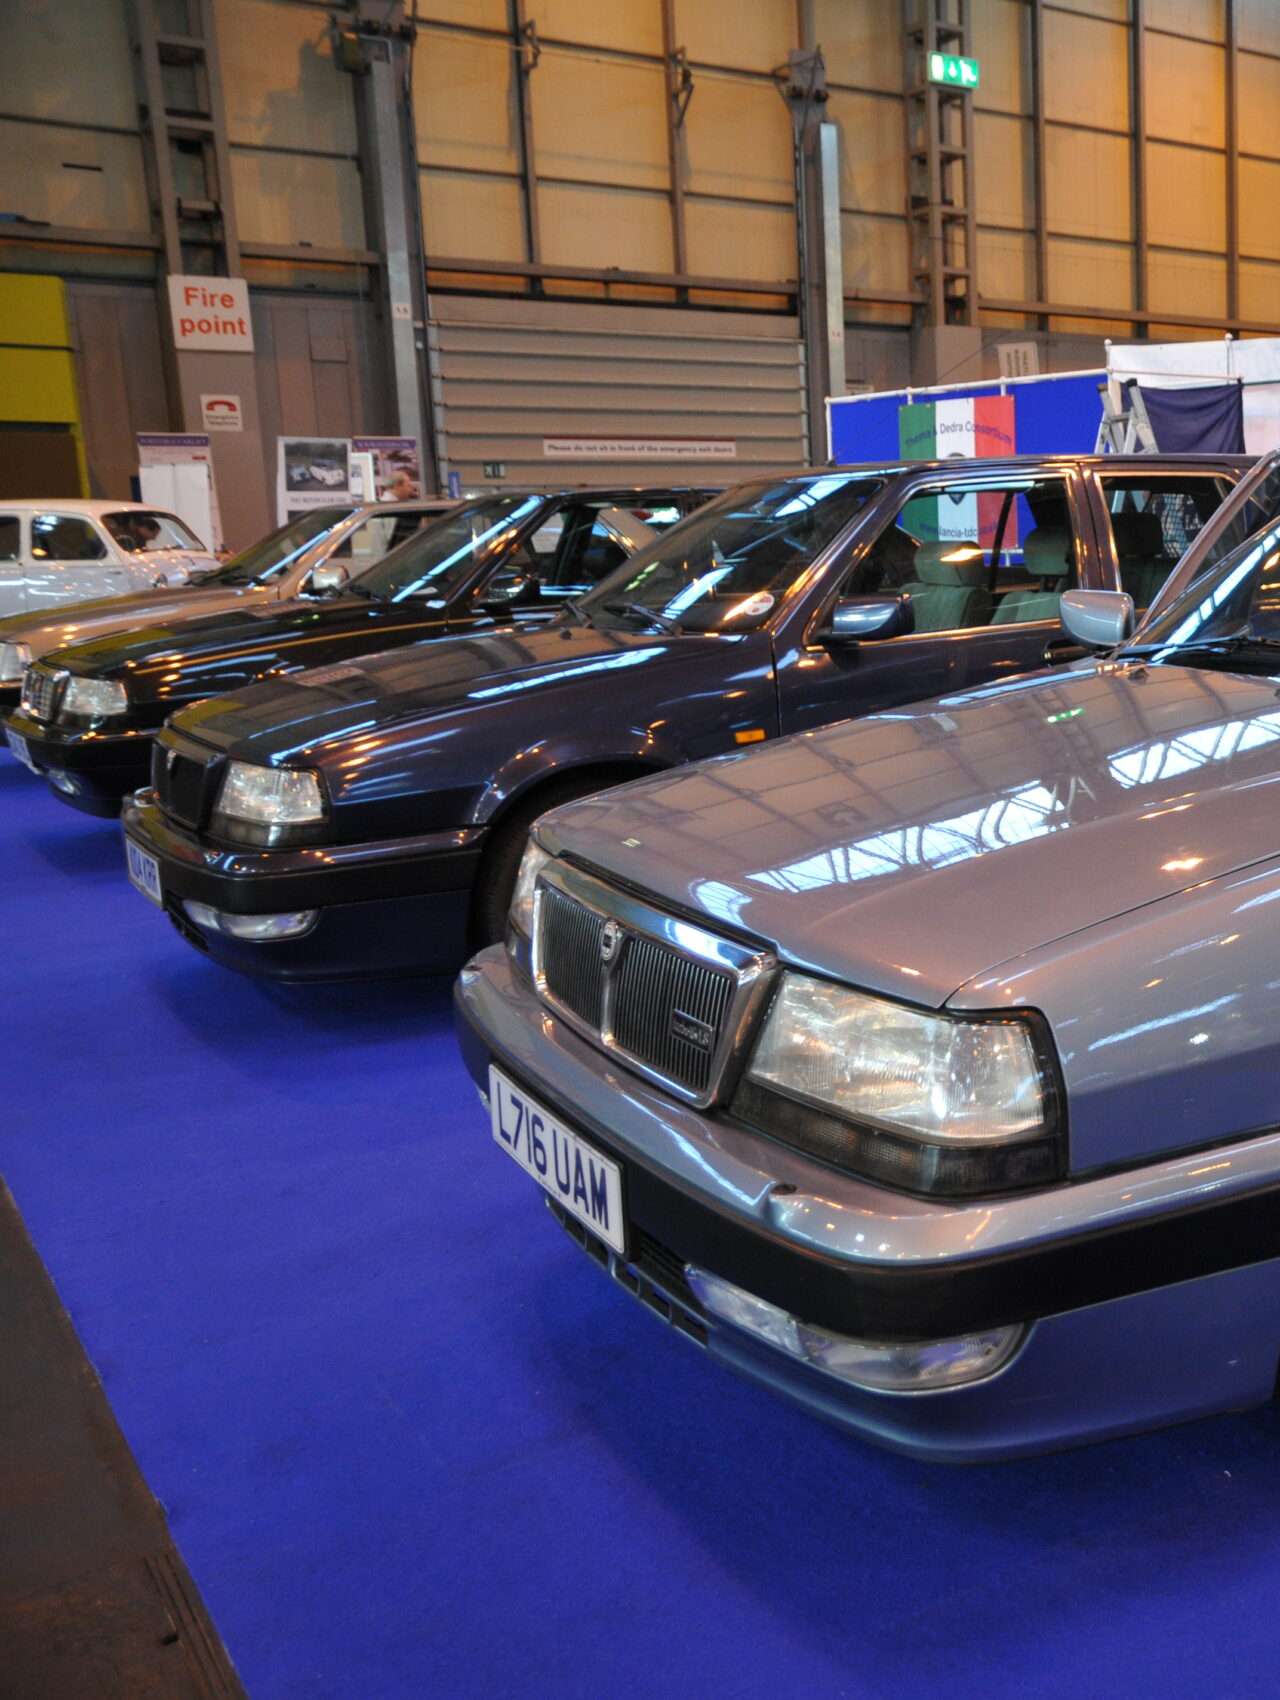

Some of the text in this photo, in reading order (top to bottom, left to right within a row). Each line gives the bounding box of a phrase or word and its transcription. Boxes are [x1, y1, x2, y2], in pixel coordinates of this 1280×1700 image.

[184, 286, 234, 308] Fire
[180, 315, 247, 337] point
[940, 422, 963, 434] Dedra
[965, 420, 1012, 446] Consortium
[497, 1082, 609, 1232] L716 UAM
